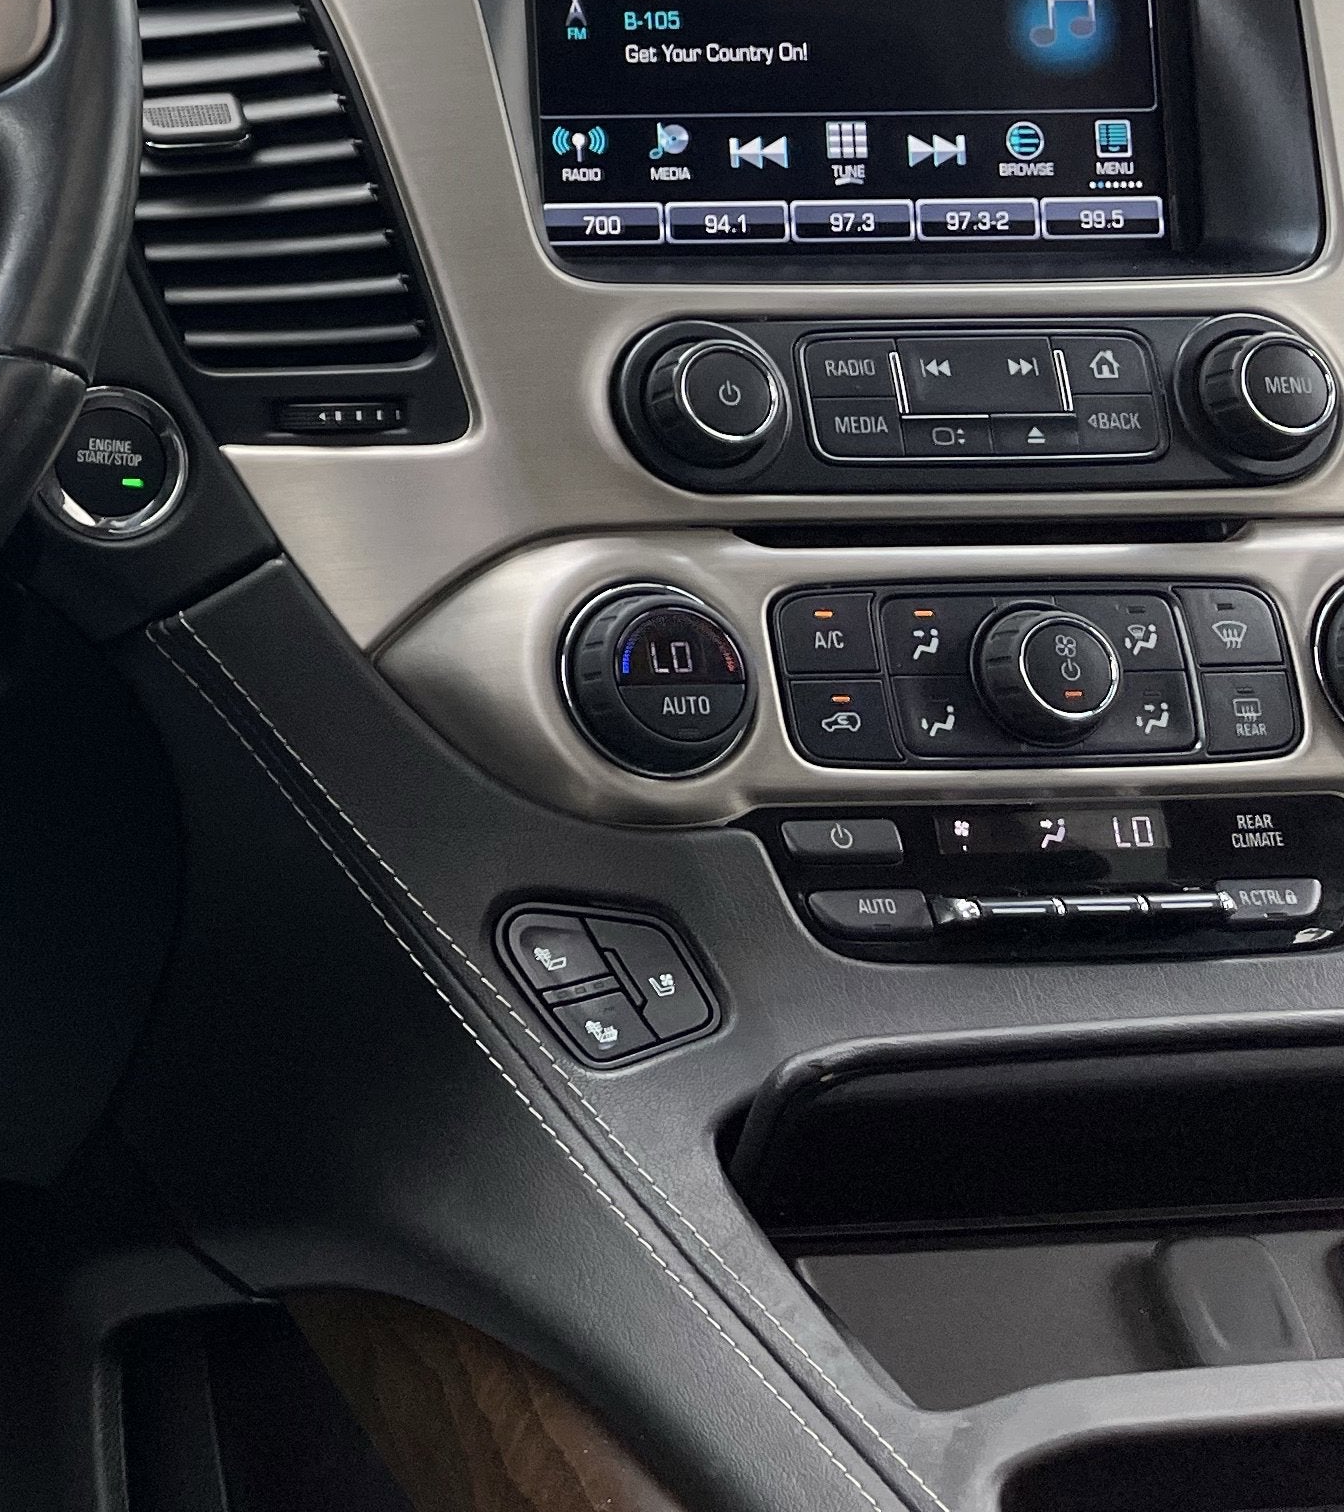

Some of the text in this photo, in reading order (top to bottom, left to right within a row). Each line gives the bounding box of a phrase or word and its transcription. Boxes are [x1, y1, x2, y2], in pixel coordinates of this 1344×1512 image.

[624, 11, 681, 30] B-105
[567, 27, 587, 40] FM
[625, 41, 808, 65] Get Your Country On!
[561, 168, 602, 181] RADIO
[650, 167, 691, 181] MEDIA
[831, 164, 866, 179] TUNE
[999, 162, 1055, 176] BROWSE
[1095, 161, 1134, 175] MENU
[583, 215, 622, 235] 700
[704, 214, 748, 234] 94.1
[829, 213, 875, 232] 97.3
[945, 211, 1010, 231] 97.3-2
[1079, 210, 1125, 229] 99.5
[824, 359, 876, 377] RADIO
[1264, 375, 1313, 394] MENU
[834, 416, 889, 434] MEDIA
[1100, 412, 1142, 430] BACK
[88, 438, 132, 453] ENGINE
[76, 450, 143, 467] START/STOP
[814, 631, 845, 649] A/C
[662, 695, 710, 715] AUTO
[1235, 722, 1268, 737] REAR
[1236, 813, 1274, 829] REAR
[1231, 831, 1285, 849] CLIMATE
[858, 898, 897, 916] AUTO
